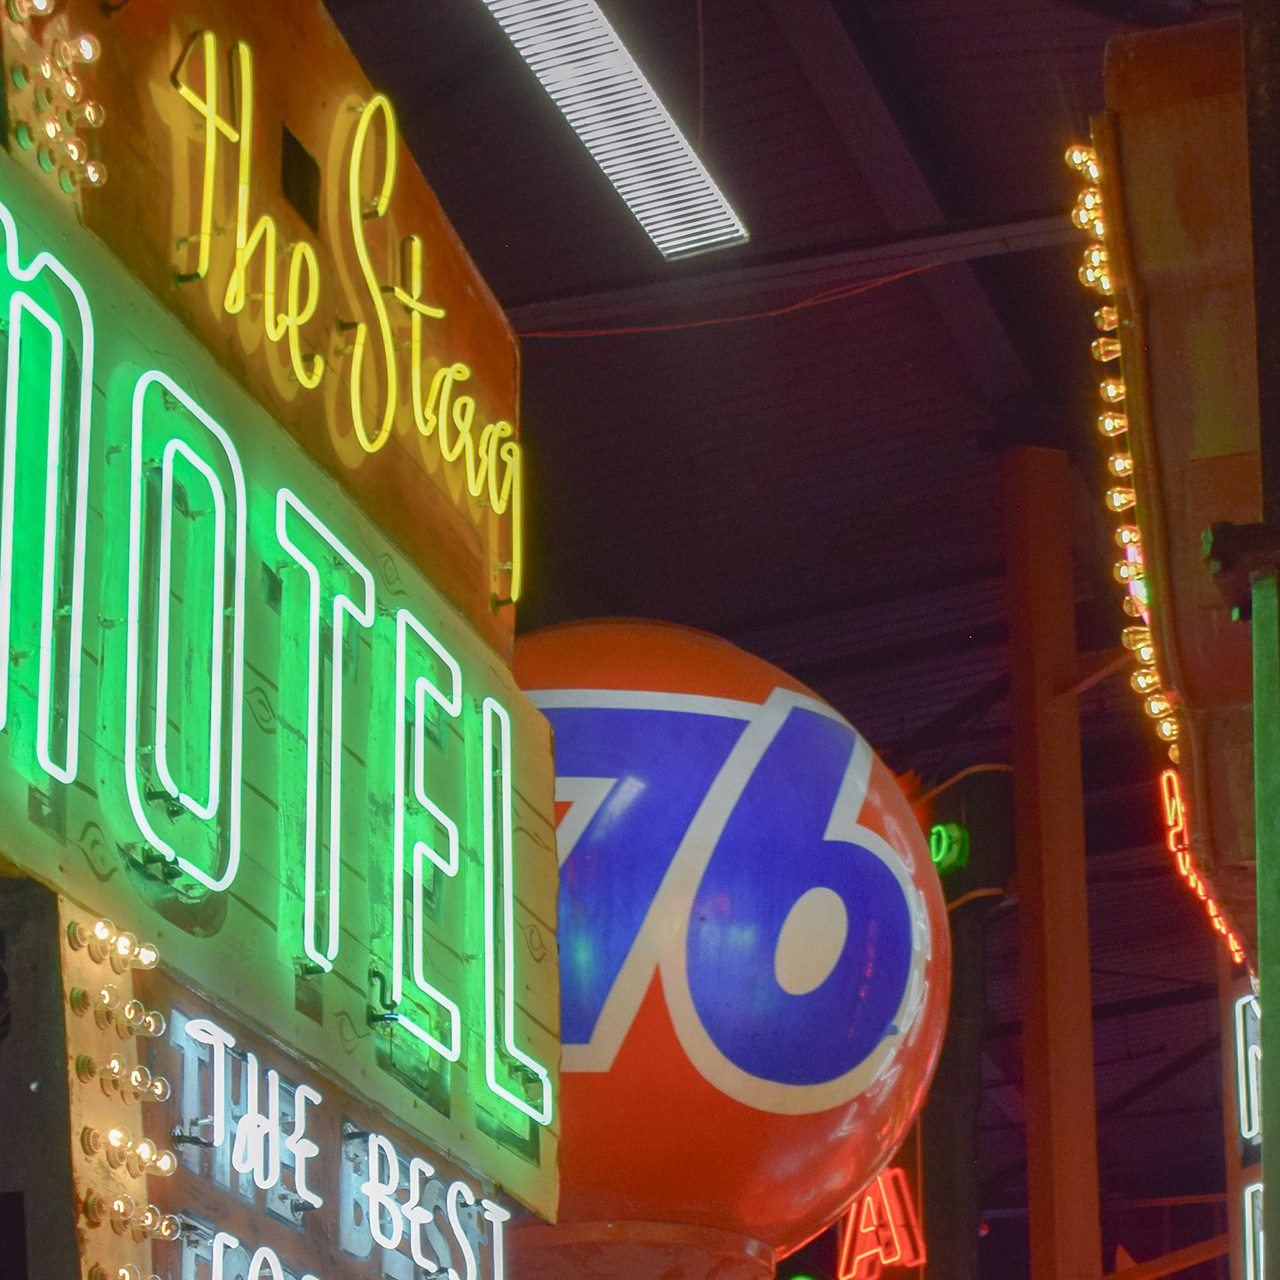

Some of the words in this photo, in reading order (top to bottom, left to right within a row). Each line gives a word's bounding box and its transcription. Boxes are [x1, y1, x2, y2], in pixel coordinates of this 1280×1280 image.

[350, 95, 521, 602] Stag
[526, 688, 926, 1114] 76
[170, 1008, 322, 1225] THE
